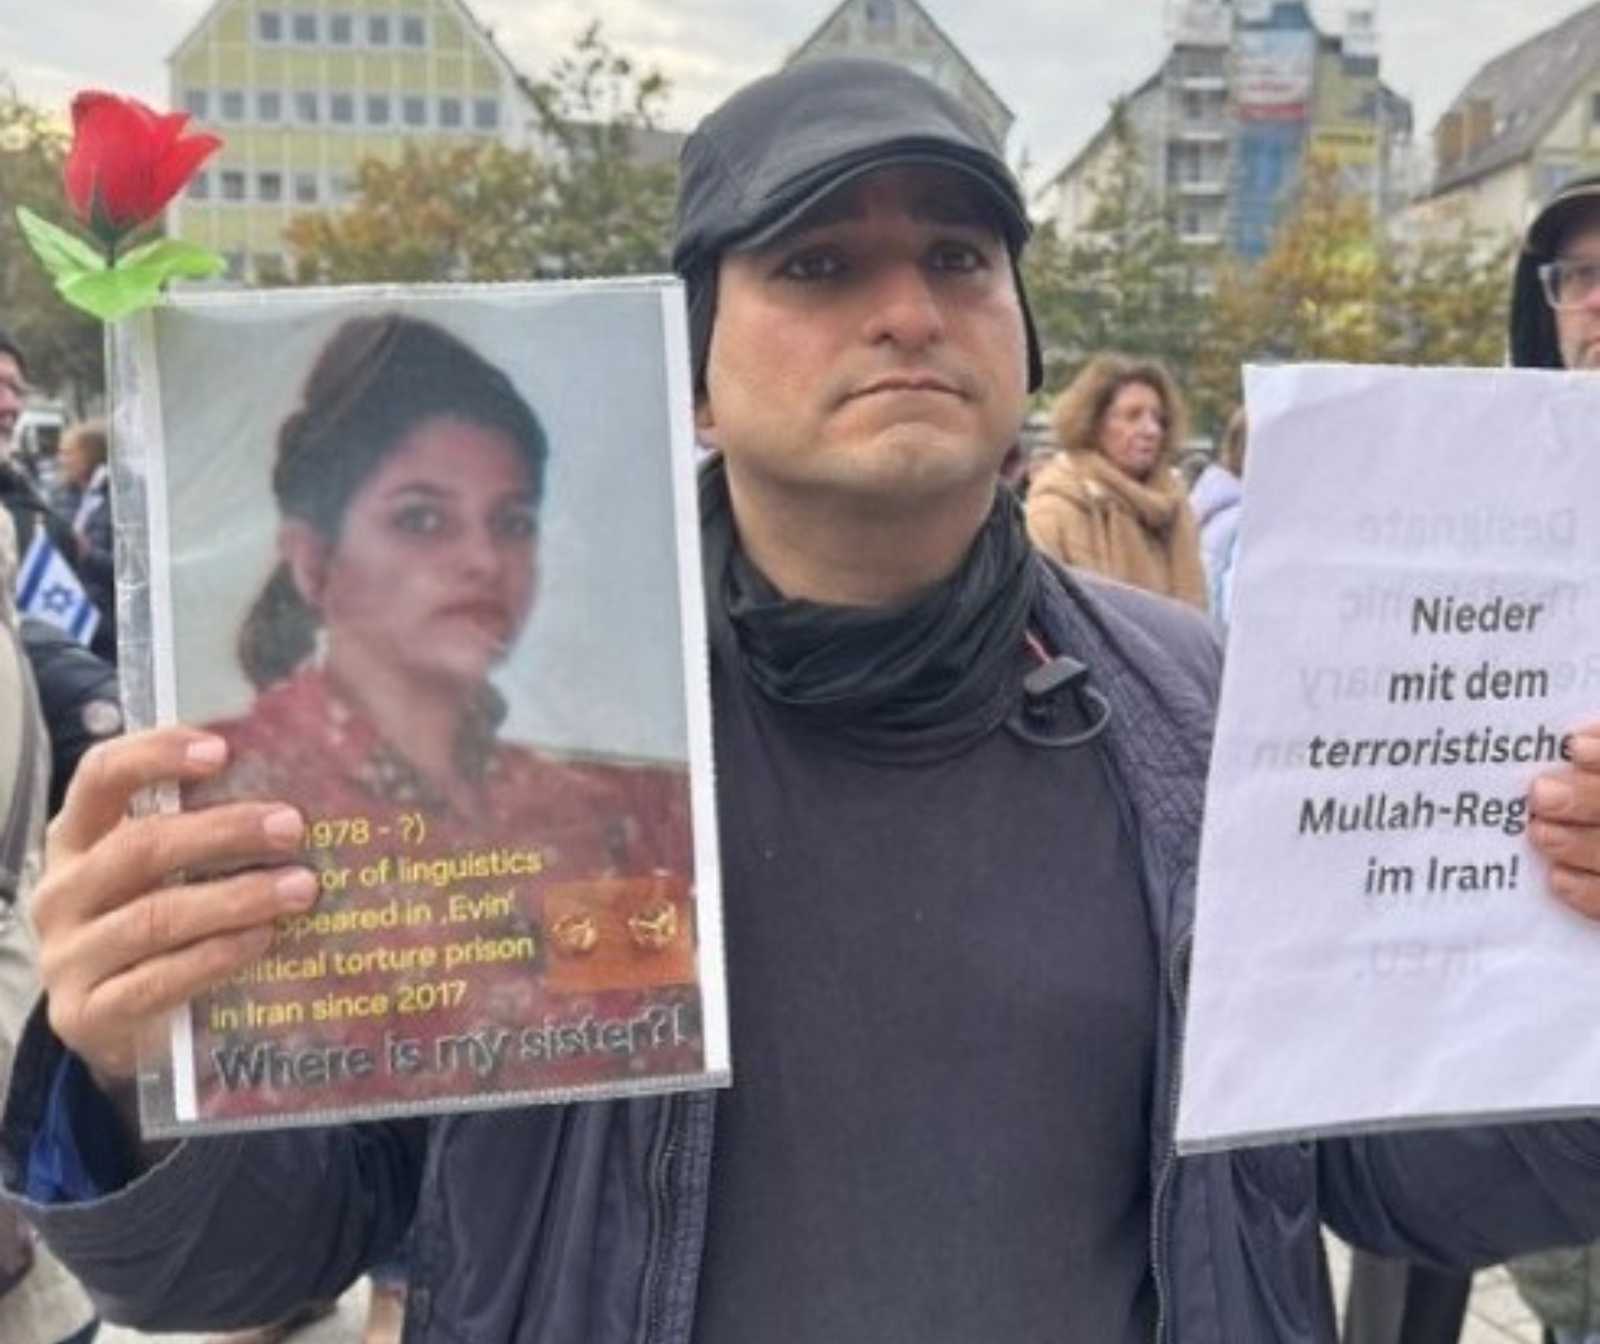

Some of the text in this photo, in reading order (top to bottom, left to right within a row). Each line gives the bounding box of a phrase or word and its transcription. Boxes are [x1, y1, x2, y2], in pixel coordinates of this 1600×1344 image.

[1411, 595, 1545, 635] Nieder
[1388, 661, 1456, 704] mit
[1465, 660, 1549, 701] dem
[1308, 724, 1575, 768] terroristische
[400, 812, 426, 845] ?)
[1298, 791, 1529, 836] Mullah-Reg
[321, 848, 543, 890] or of linguistics
[1363, 853, 1520, 894] im Iran!
[403, 898, 432, 926] in
[335, 946, 438, 976] torture
[445, 934, 535, 970] prison
[211, 979, 468, 1030] in Iran since 2017
[209, 1038, 377, 1092] Where
[383, 1029, 423, 1075] is
[435, 1025, 511, 1077] my
